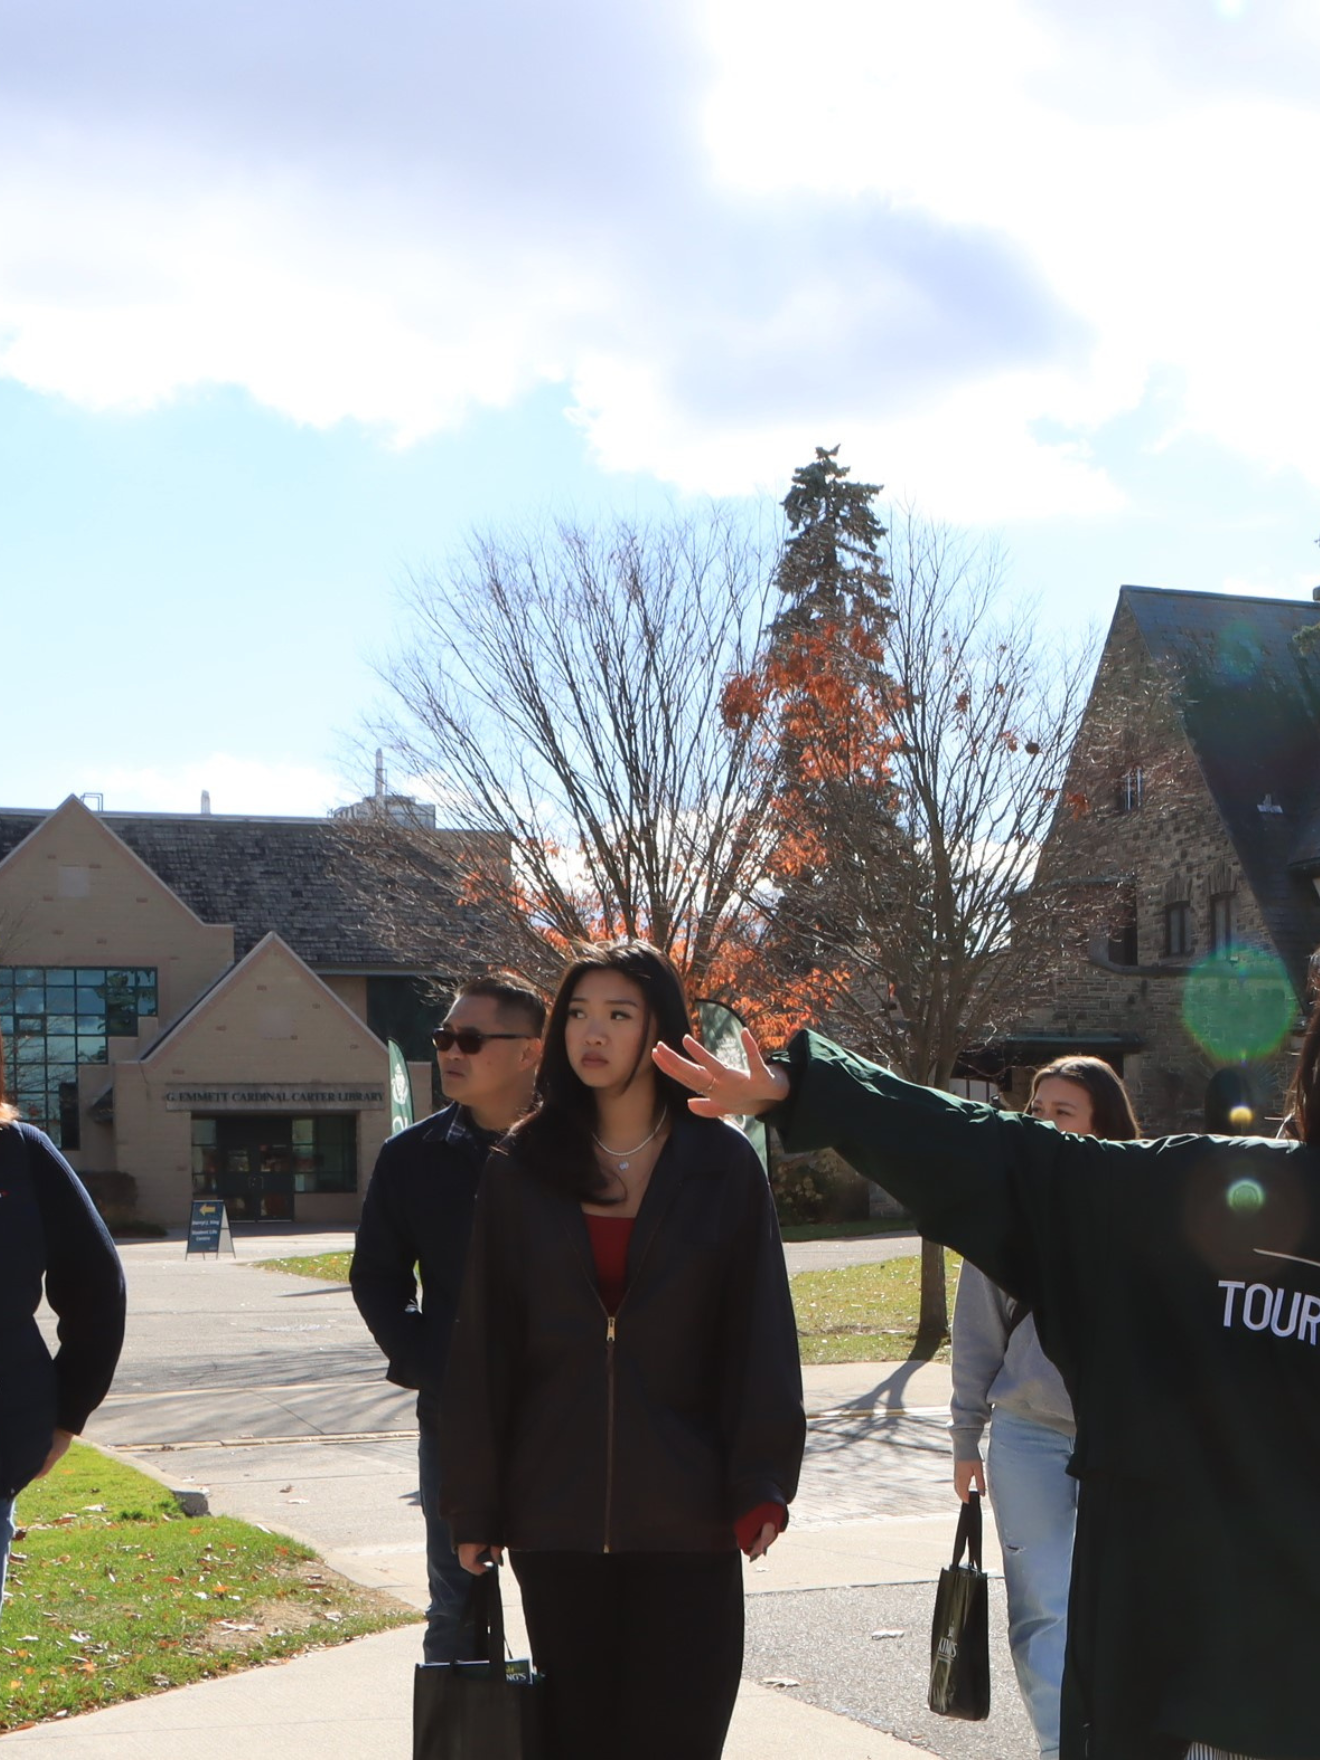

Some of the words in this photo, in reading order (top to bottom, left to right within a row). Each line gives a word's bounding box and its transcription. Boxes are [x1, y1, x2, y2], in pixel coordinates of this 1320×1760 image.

[179, 1092, 228, 1101] EMMETT
[232, 1092, 287, 1101] CARDINAL
[292, 1092, 336, 1101] CARTER
[338, 1092, 383, 1101] LIBRARY
